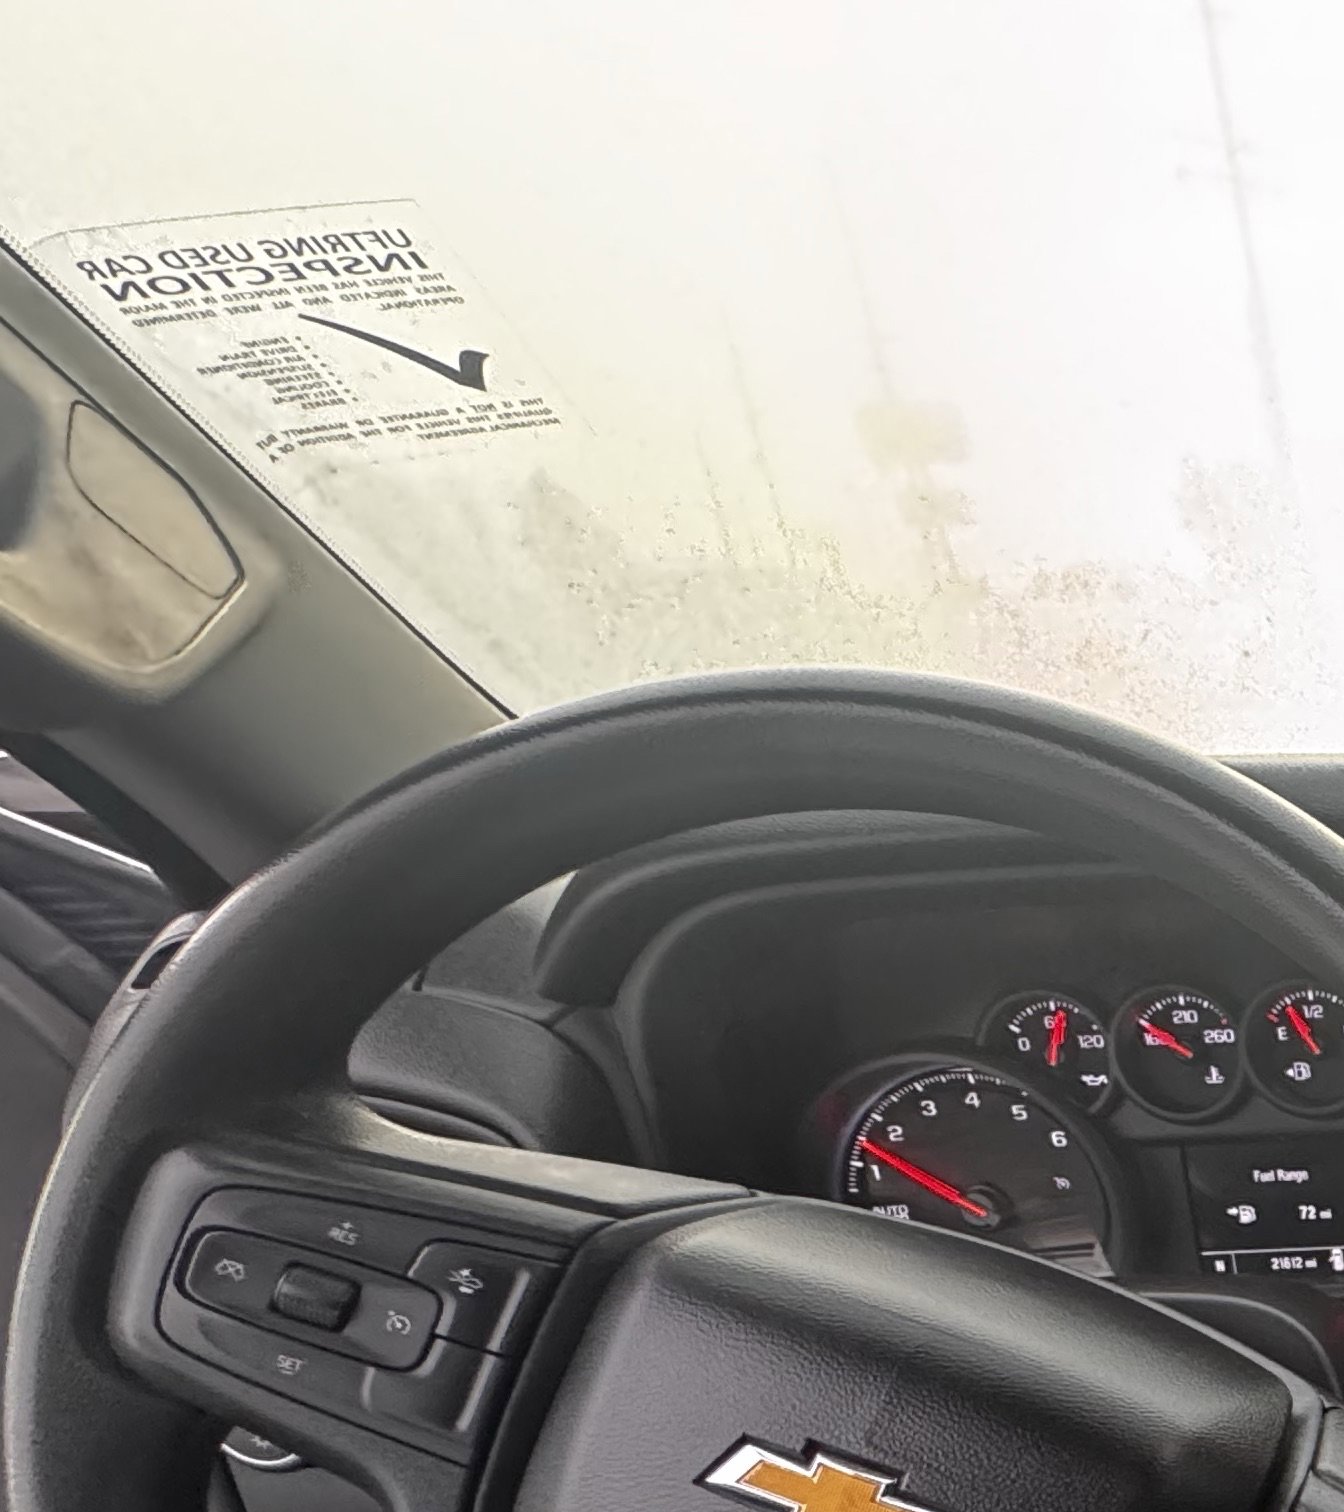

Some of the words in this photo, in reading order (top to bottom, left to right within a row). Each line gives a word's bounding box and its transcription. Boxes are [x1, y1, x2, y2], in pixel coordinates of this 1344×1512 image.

[1172, 1010, 1198, 1024] 210
[1077, 1034, 1105, 1049] 120
[1203, 1029, 1236, 1044] 260
[1277, 1026, 1288, 1041] E
[1018, 1037, 1031, 1051] 0
[964, 1091, 981, 1108] 4
[921, 1100, 938, 1117] 3
[1011, 1104, 1028, 1121] 5
[887, 1125, 904, 1142] 2
[1051, 1131, 1068, 1147] 6
[870, 1164, 882, 1181] 1
[1253, 1169, 1275, 1183] Fuel
[1277, 1168, 1310, 1184] Range
[1298, 1205, 1317, 1220] 72
[276, 1354, 304, 1372] SET
